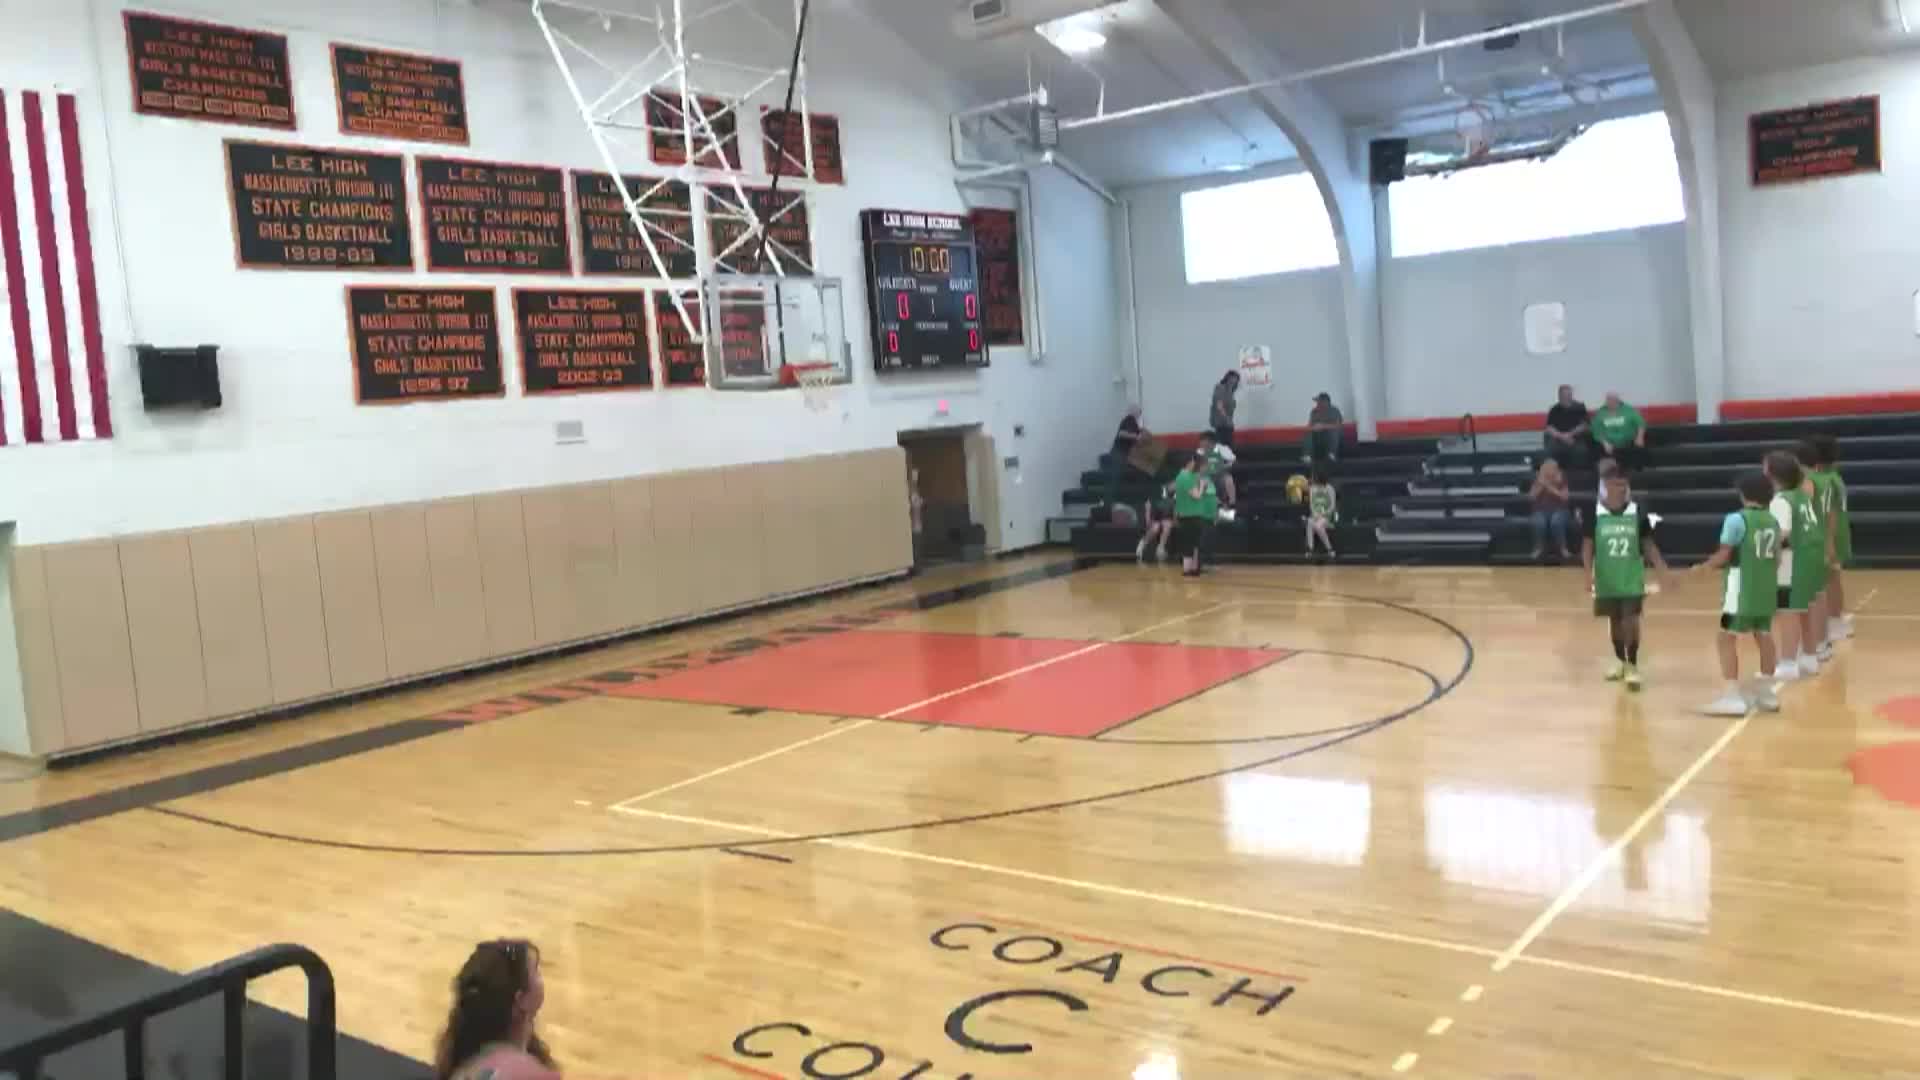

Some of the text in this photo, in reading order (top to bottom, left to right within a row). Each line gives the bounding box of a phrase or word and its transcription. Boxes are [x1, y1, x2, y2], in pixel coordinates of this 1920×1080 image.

[271, 154, 368, 176] LEE HIGH
[243, 172, 331, 197] MASSACHUSETTS
[448, 167, 537, 187] LEE HIGH
[251, 196, 394, 223] STATE CHAMPIONS
[431, 205, 561, 228] STATE CHAMPIONS
[257, 221, 393, 244] GIRLS BASKETBALL
[436, 225, 559, 248] GIRLS BASKETBALL
[384, 293, 465, 310] LEE HIGH
[547, 295, 579, 311] LEE
[965, 293, 977, 320] 0
[367, 334, 486, 353] STATE CHAMPIONS
[534, 331, 636, 349] STATE CHAMPIONS
[374, 355, 485, 374] GIRLS BASKETBALL
[572, 351, 637, 367] BASKETBALL
[1607, 537, 1630, 557] 22
[1754, 527, 1776, 559] 12
[930, 923, 1296, 1017] COACH
[943, 988, 1090, 1055] C
